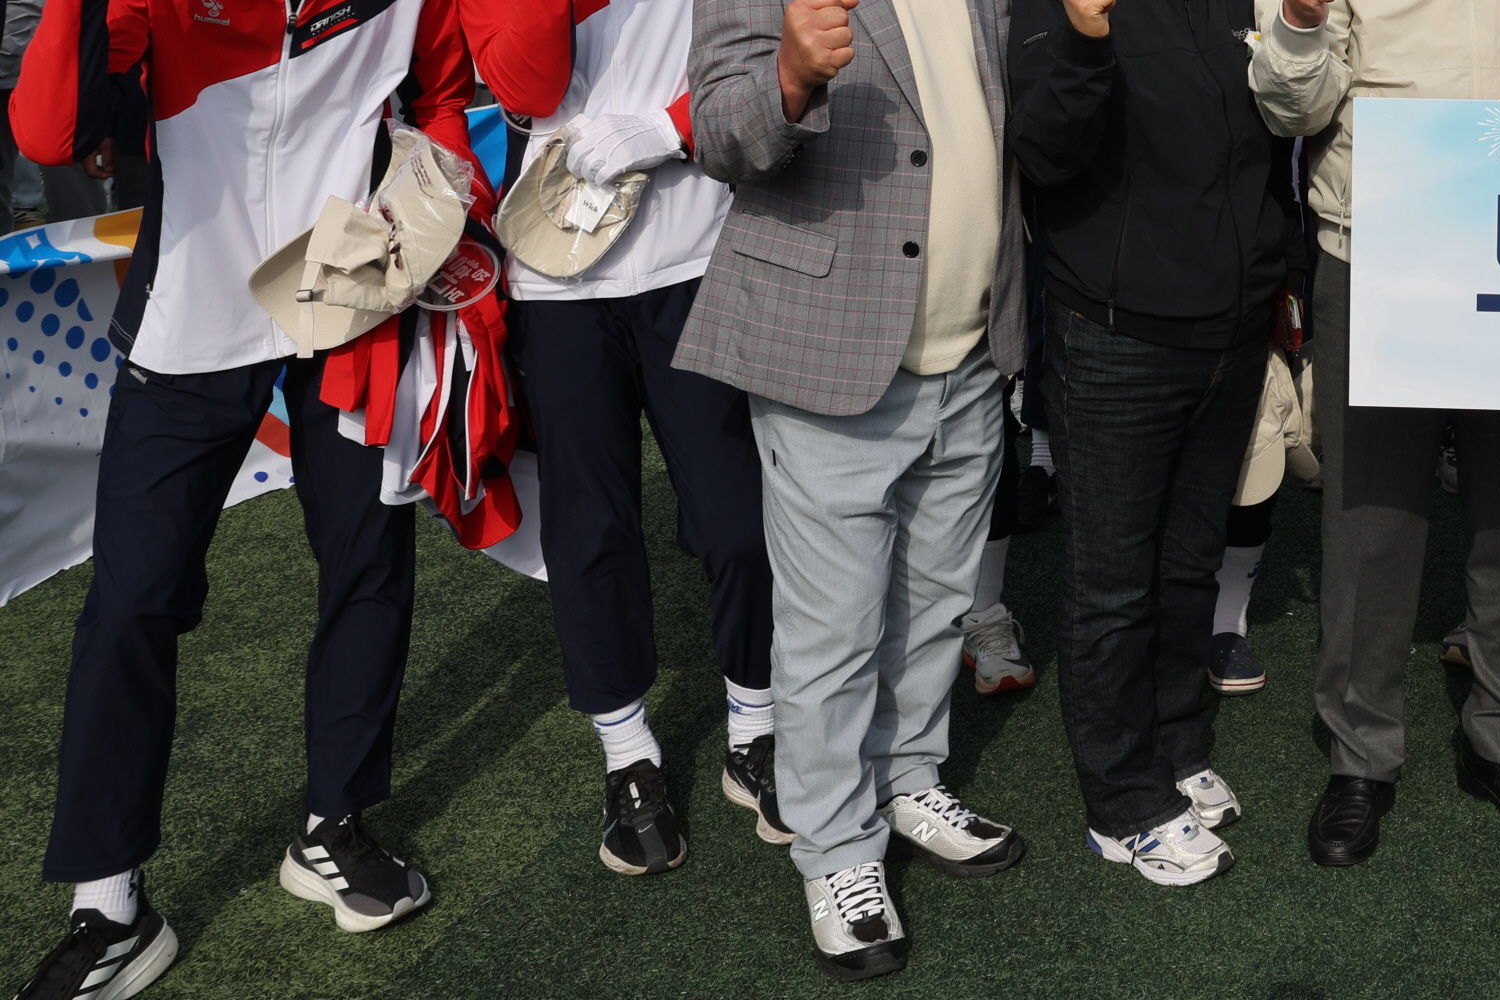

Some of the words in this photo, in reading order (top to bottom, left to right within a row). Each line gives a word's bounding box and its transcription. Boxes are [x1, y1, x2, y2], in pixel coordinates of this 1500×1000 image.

[193, 13, 231, 26] hummel
[310, 5, 352, 33] DANISH
[583, 199, 599, 213] Wick
